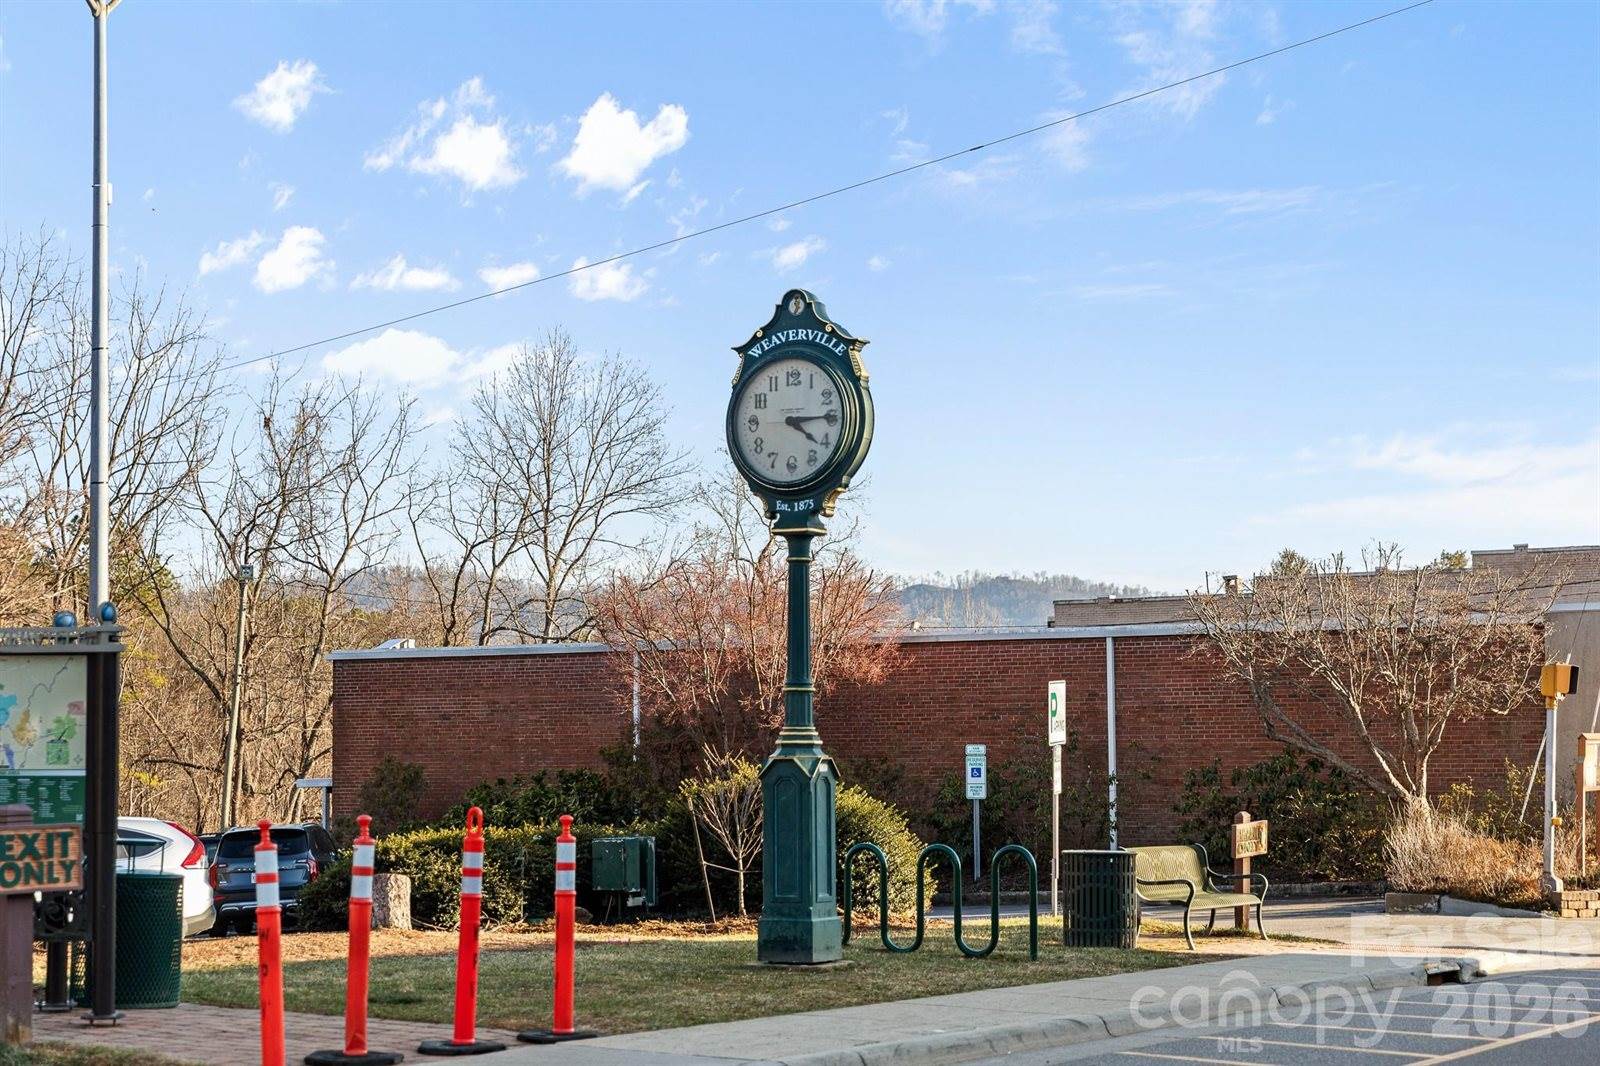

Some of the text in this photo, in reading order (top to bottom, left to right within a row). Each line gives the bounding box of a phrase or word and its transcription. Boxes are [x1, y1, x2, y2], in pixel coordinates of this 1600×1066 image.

[747, 329, 847, 358] WEAVERVILLE
[786, 369, 802, 387] 12
[754, 392, 767, 409] 10
[821, 389, 833, 406] 2
[748, 415, 760, 433] 9
[754, 437, 763, 454] 8
[820, 433, 831, 449] 4
[767, 452, 779, 469] 7
[786, 455, 798, 473] 6
[794, 500, 815, 512] 1875
[0, 832, 74, 861] EXIT
[0, 861, 77, 888] ONLY
